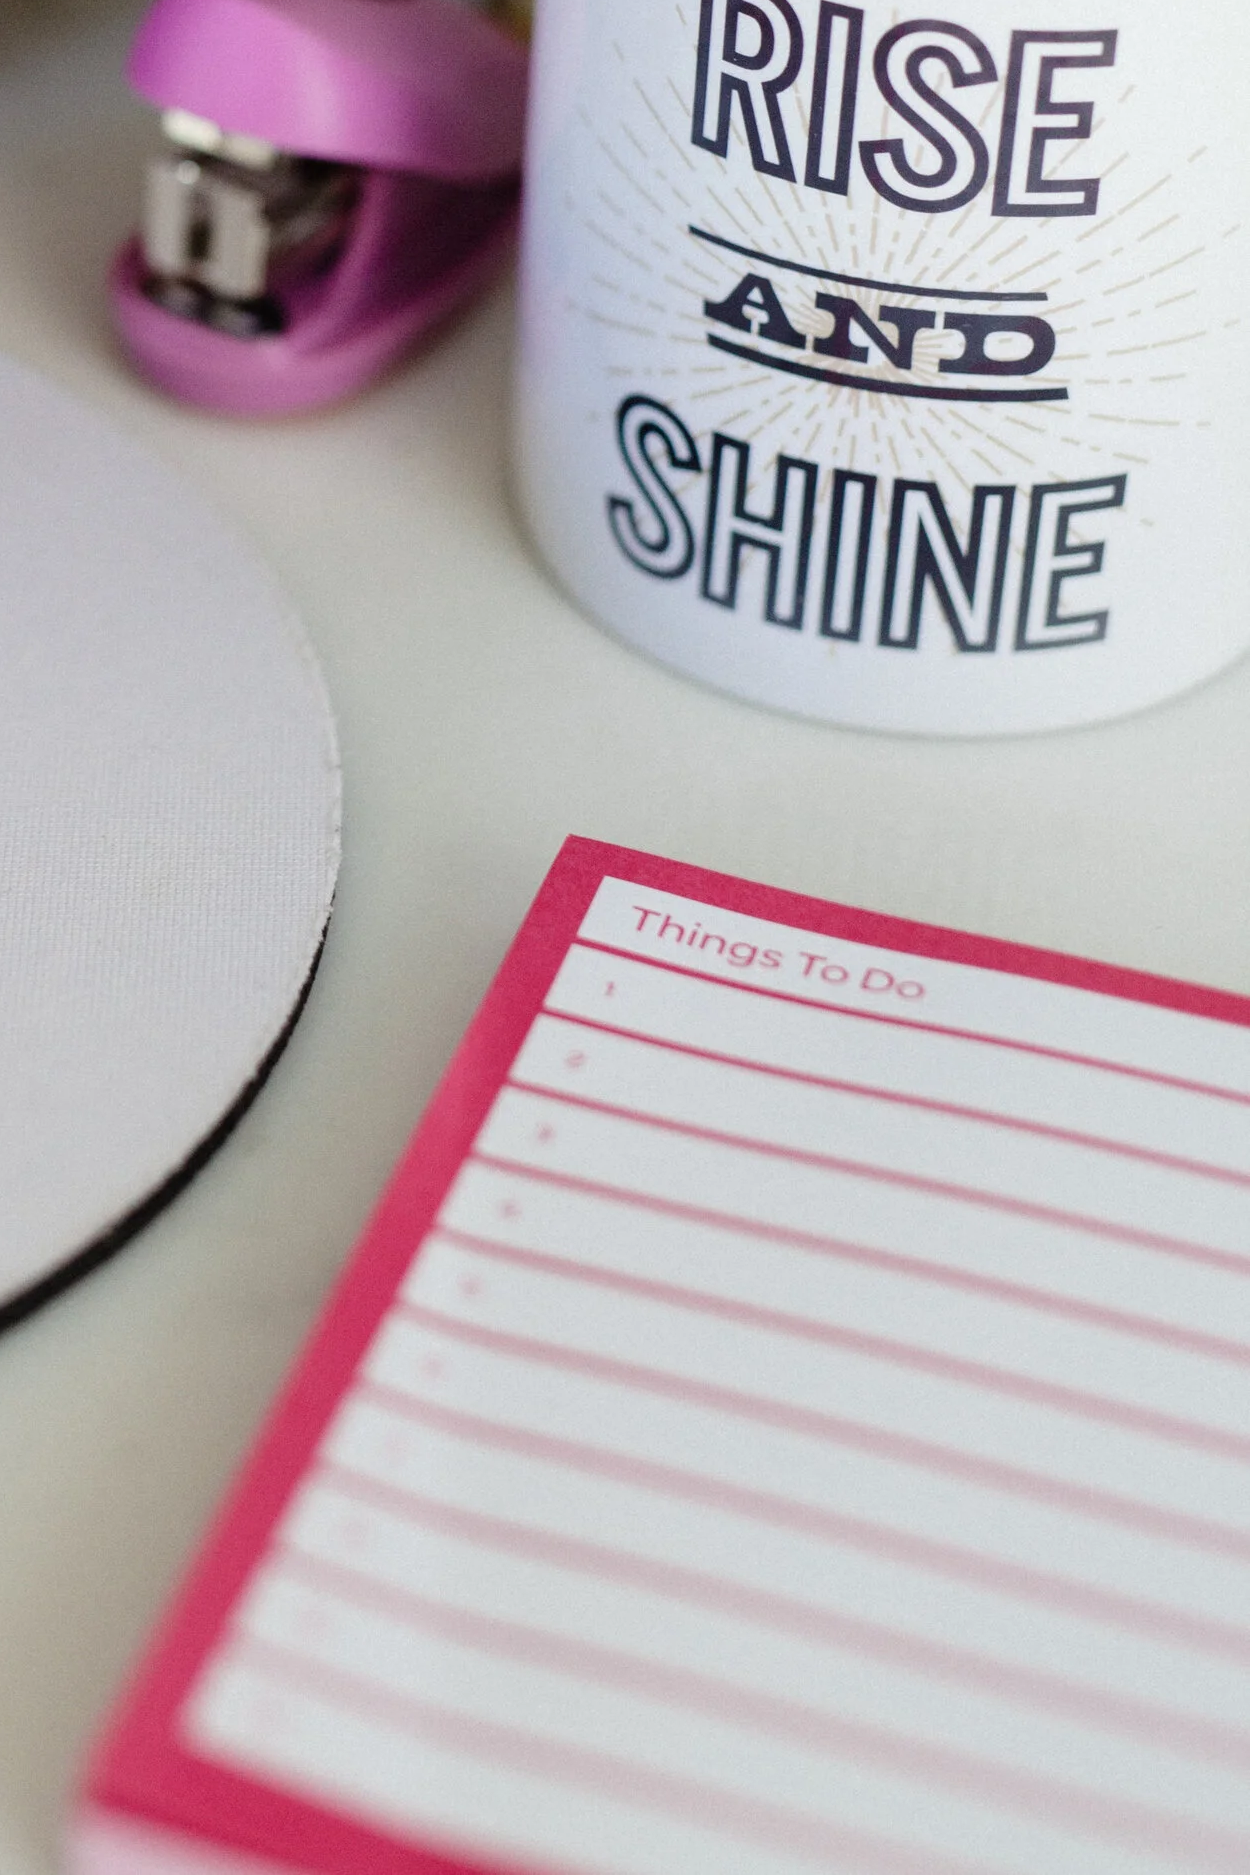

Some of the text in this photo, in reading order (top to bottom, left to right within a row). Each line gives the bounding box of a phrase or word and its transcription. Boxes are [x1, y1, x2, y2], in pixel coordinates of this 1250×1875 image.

[703, 272, 1057, 377] AND
[607, 393, 1128, 653] SHINE
[631, 905, 926, 1000] Things To Do
